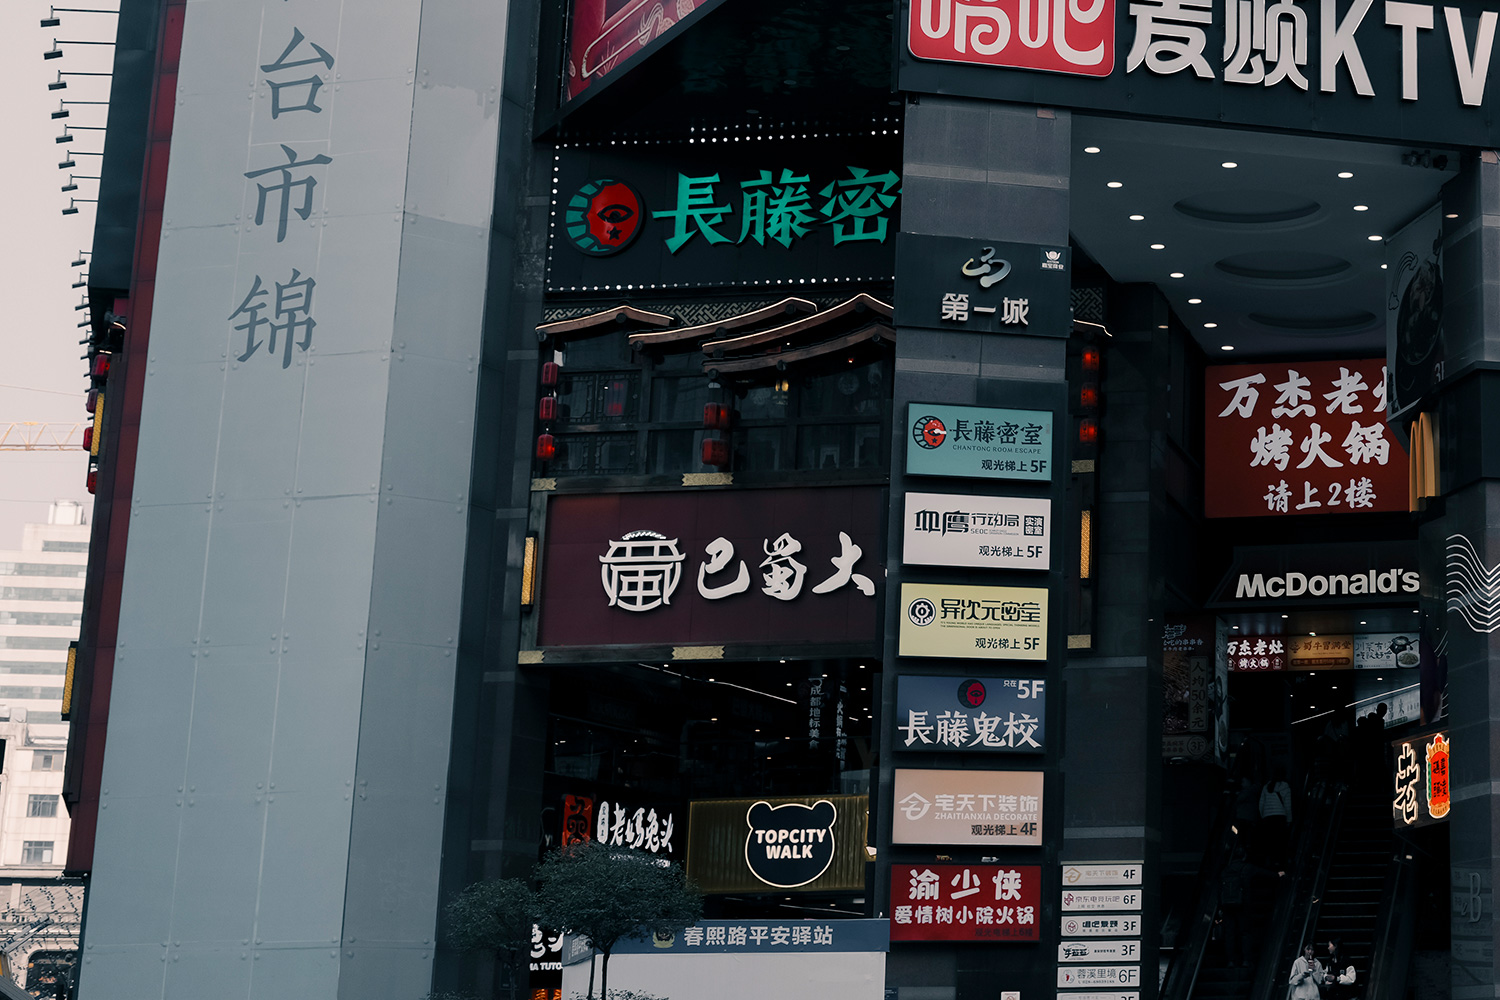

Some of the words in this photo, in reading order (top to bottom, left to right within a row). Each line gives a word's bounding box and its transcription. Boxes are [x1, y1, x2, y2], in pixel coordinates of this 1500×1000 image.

[652, 166, 902, 255] 長藤密
[941, 292, 1029, 326] 第一城
[949, 419, 1043, 446] 長藤密室
[952, 444, 991, 452] CHANTONG
[1250, 420, 1390, 471] 烤火锅
[981, 460, 1028, 472] 观光梯上
[1030, 460, 1047, 473] 5F
[1263, 476, 1377, 513] 请上2楼
[979, 545, 1024, 558] 观光梯上
[1027, 545, 1043, 558] 5F
[698, 531, 887, 600] 巴蜀大
[1235, 568, 1421, 599] McDonald's
[940, 598, 1040, 622] 异次元密室
[975, 638, 1021, 649] 观光梯上
[1024, 637, 1040, 650] 5F
[1227, 639, 1285, 656] 万杰老灶
[1003, 680, 1016, 688] 只在
[1017, 680, 1045, 699] 5F
[898, 709, 1042, 748] 長藤鬼校
[935, 794, 1039, 812] 宅天下装饰
[935, 812, 992, 820] ZHAITIANXIA
[993, 813, 1038, 821] DECORATE
[755, 829, 826, 843] TOPCITY
[971, 824, 1018, 836] 观光梯上
[1020, 822, 1037, 835] 4F
[765, 845, 813, 859] WALK
[1123, 869, 1136, 879] 4F
[909, 869, 1022, 900] 渝少侠
[1123, 895, 1136, 905] 6F
[894, 905, 1034, 925] 爱情树小院火锅
[1123, 921, 1136, 931] 3F
[684, 925, 834, 947] 春熙路平安驿站
[1121, 945, 1136, 956] 3F
[1118, 969, 1137, 983] 6F
